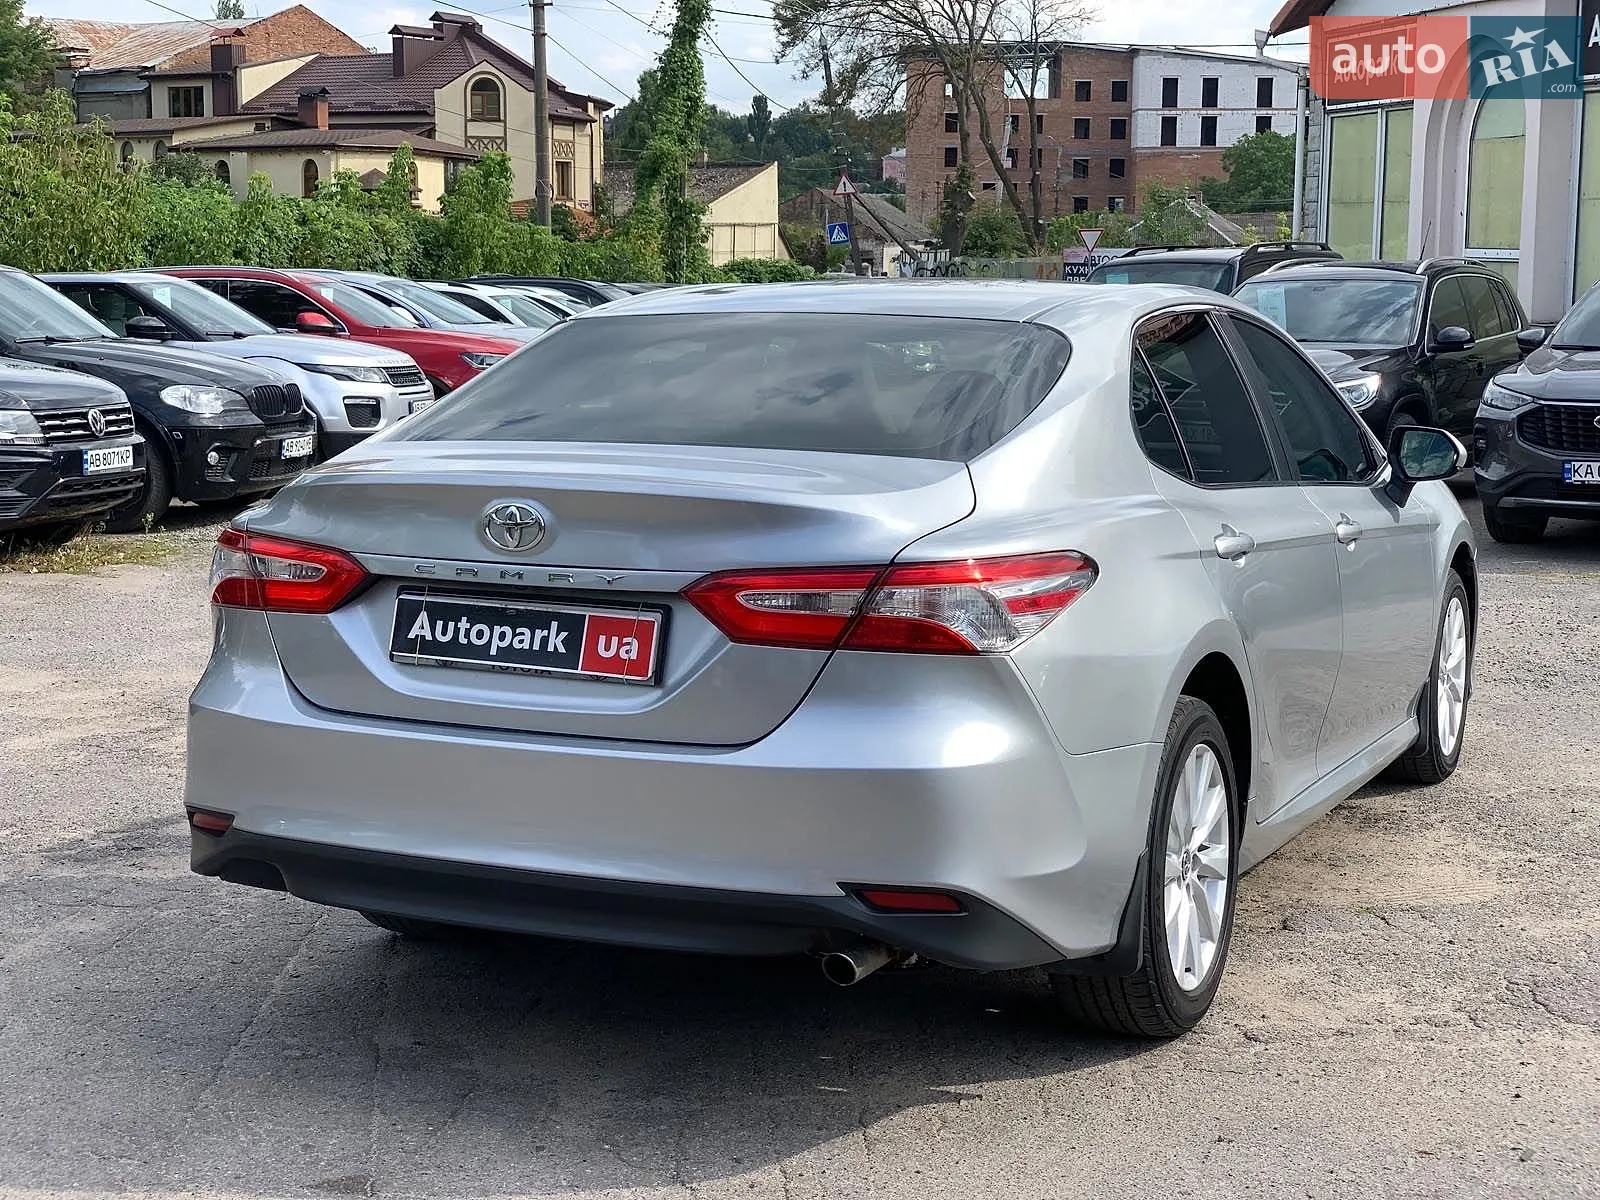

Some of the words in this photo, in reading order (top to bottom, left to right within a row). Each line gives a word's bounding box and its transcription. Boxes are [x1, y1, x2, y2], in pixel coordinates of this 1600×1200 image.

[90, 453, 101, 468] AB
[414, 563, 628, 585] CAMRY
[407, 610, 569, 656] Autopark
[597, 633, 639, 660] ua
